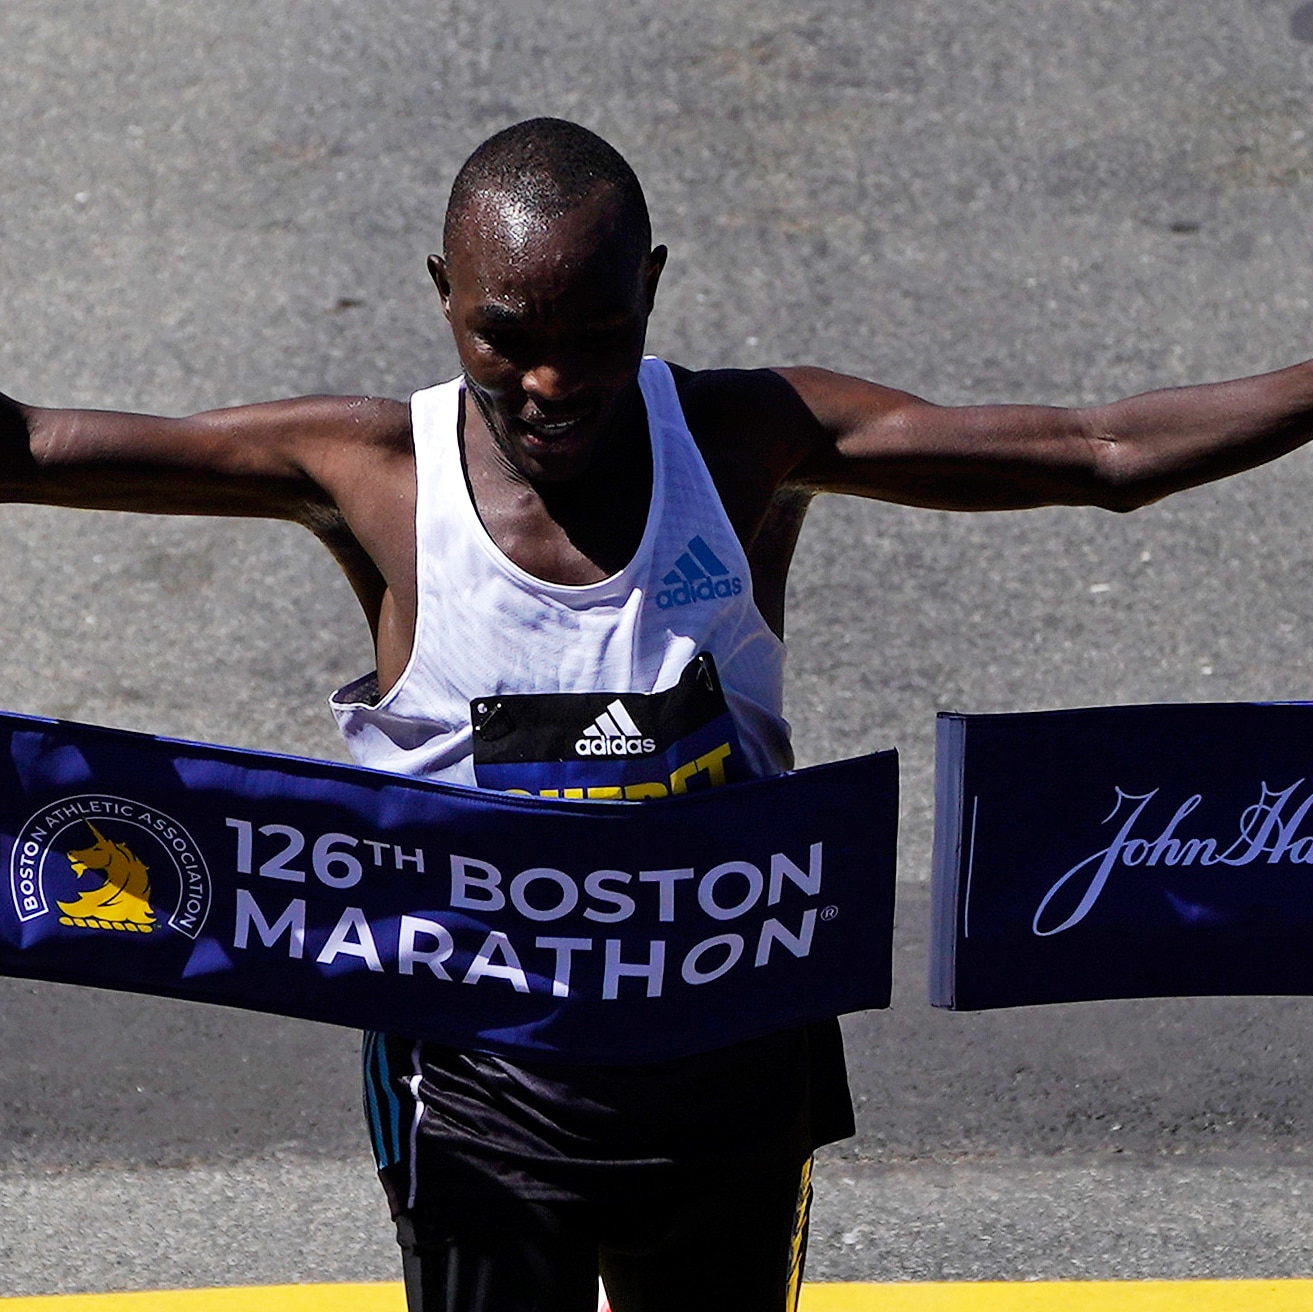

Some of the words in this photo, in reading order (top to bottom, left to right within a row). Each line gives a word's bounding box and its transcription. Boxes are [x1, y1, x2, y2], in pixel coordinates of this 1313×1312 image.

[655, 574, 742, 610] adidas
[574, 734, 656, 757] adidas
[19, 825, 48, 912] BOSTON
[44, 800, 134, 829] ATHLETIC
[138, 811, 204, 929] ASSOCIATION
[224, 816, 425, 890] 126TH
[447, 841, 824, 924] BOSTON
[1032, 785, 1218, 937] John
